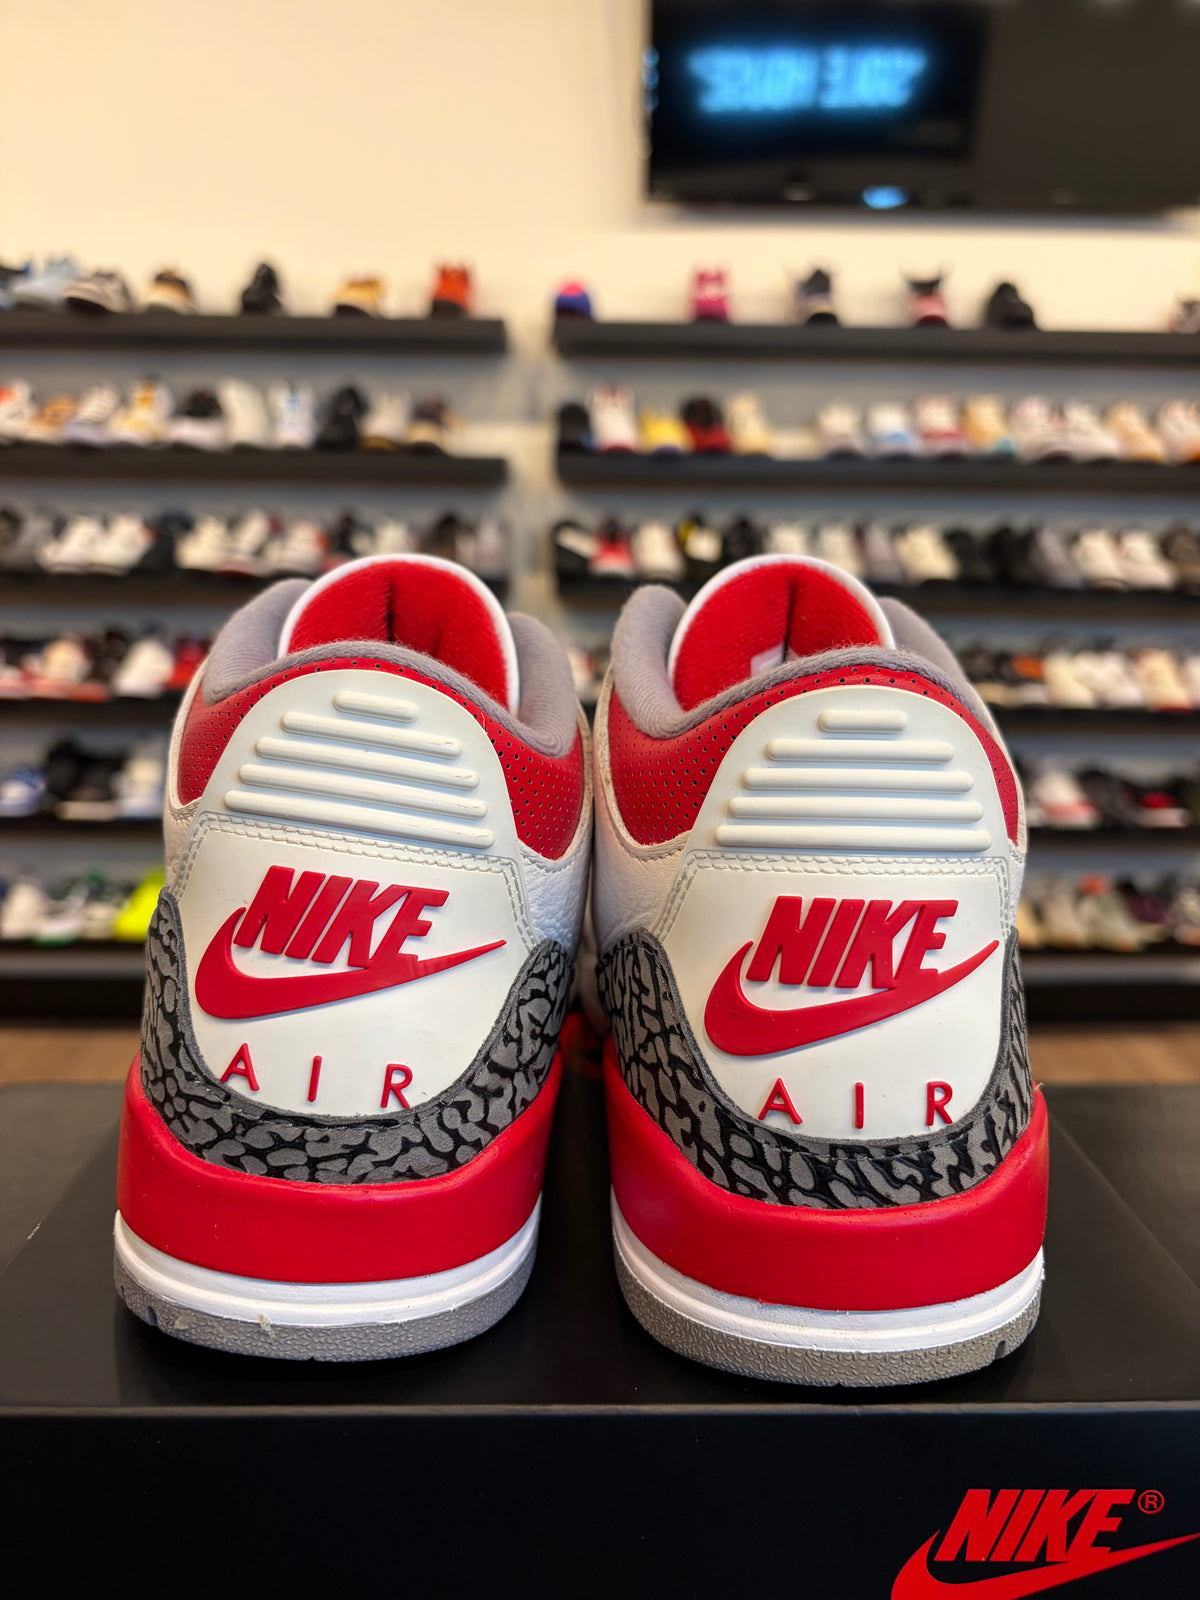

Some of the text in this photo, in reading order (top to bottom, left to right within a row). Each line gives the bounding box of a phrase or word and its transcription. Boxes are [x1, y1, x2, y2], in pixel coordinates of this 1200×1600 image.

[233, 865, 449, 970] NIKE
[745, 895, 959, 989] NIKE
[220, 1042, 411, 1110] AIR
[757, 1077, 953, 1130] AIR
[933, 1488, 1136, 1562] NIKE
